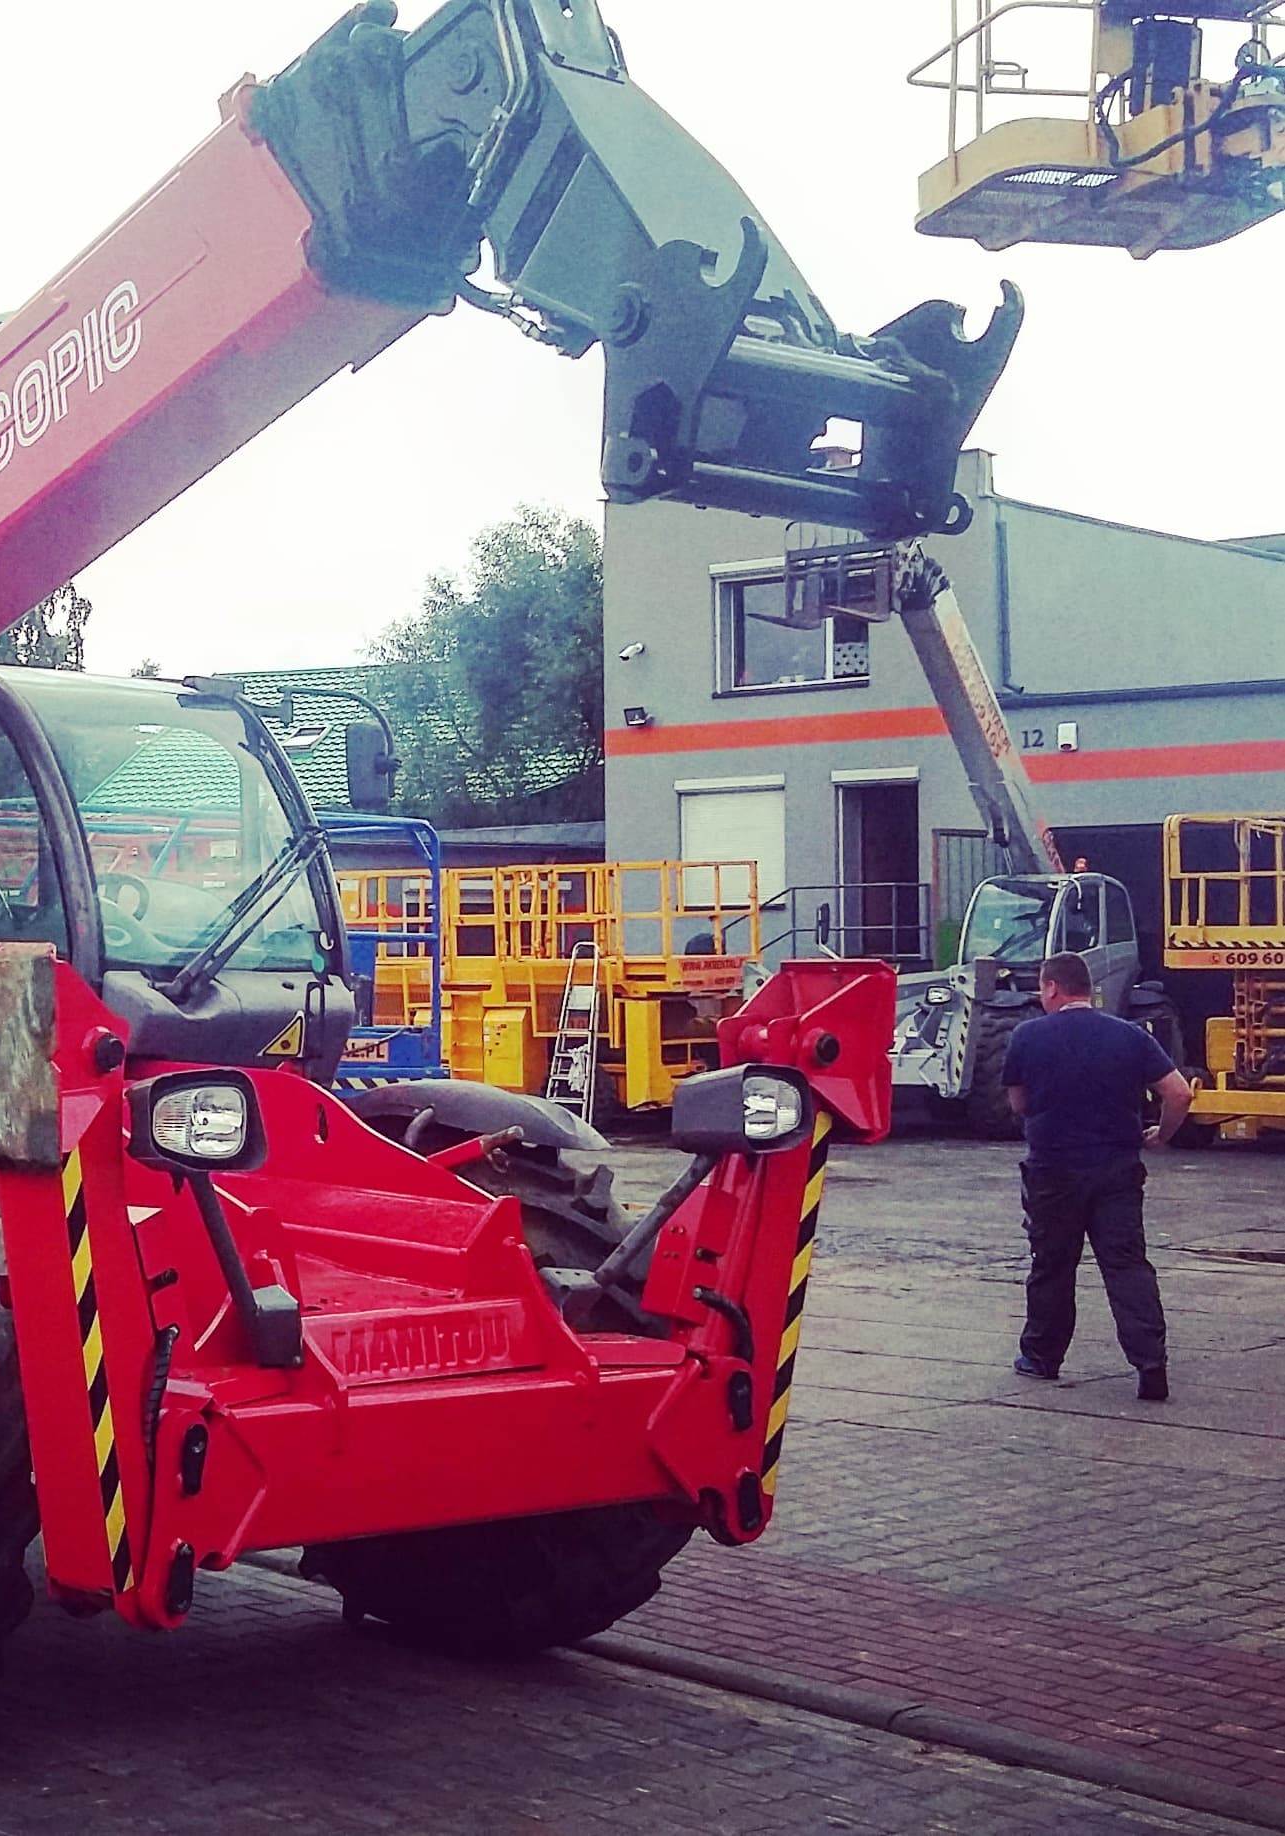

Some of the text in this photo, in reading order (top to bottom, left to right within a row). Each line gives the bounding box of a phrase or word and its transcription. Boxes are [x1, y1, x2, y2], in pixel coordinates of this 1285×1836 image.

[1022, 729, 1044, 748] 12
[1226, 952, 1258, 965] 609
[330, 1314, 511, 1379] MANITOU
